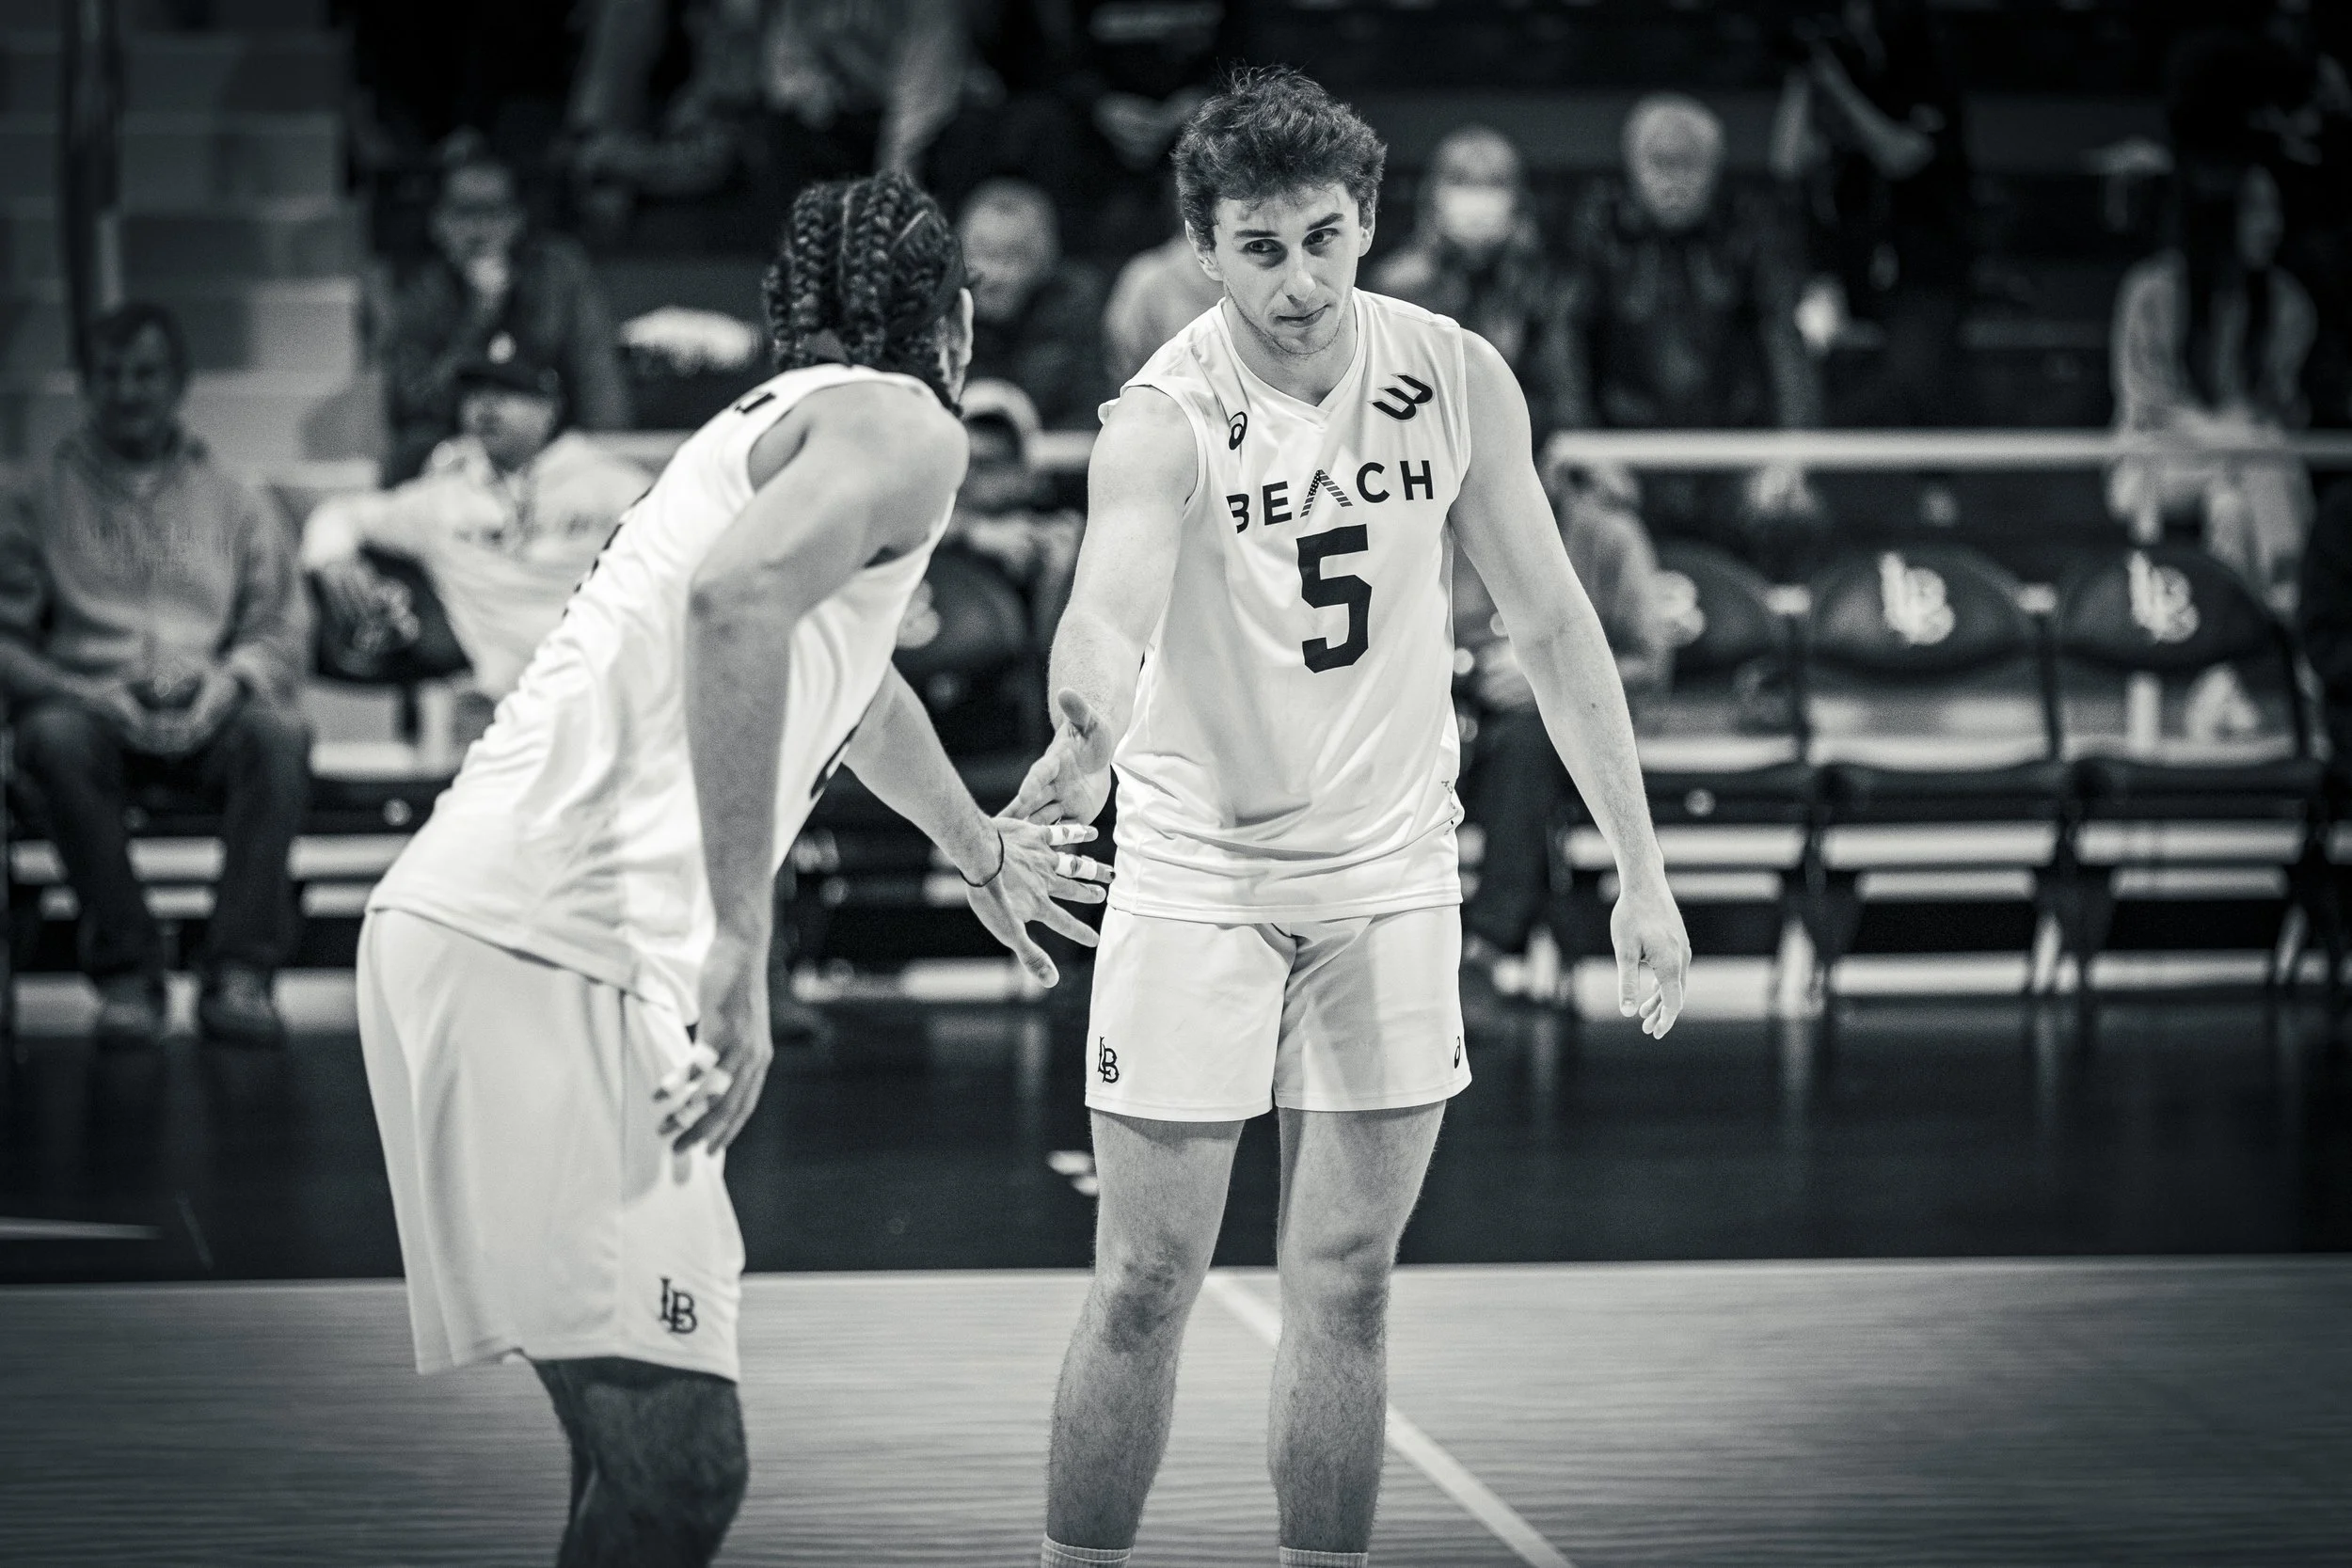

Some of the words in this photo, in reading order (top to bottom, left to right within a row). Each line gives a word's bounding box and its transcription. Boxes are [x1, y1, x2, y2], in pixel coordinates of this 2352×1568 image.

[1226, 459, 1434, 534] BEACH
[1295, 523, 1373, 673] 5
[1097, 1036, 1120, 1084] LB
[658, 1276, 697, 1334] LB
